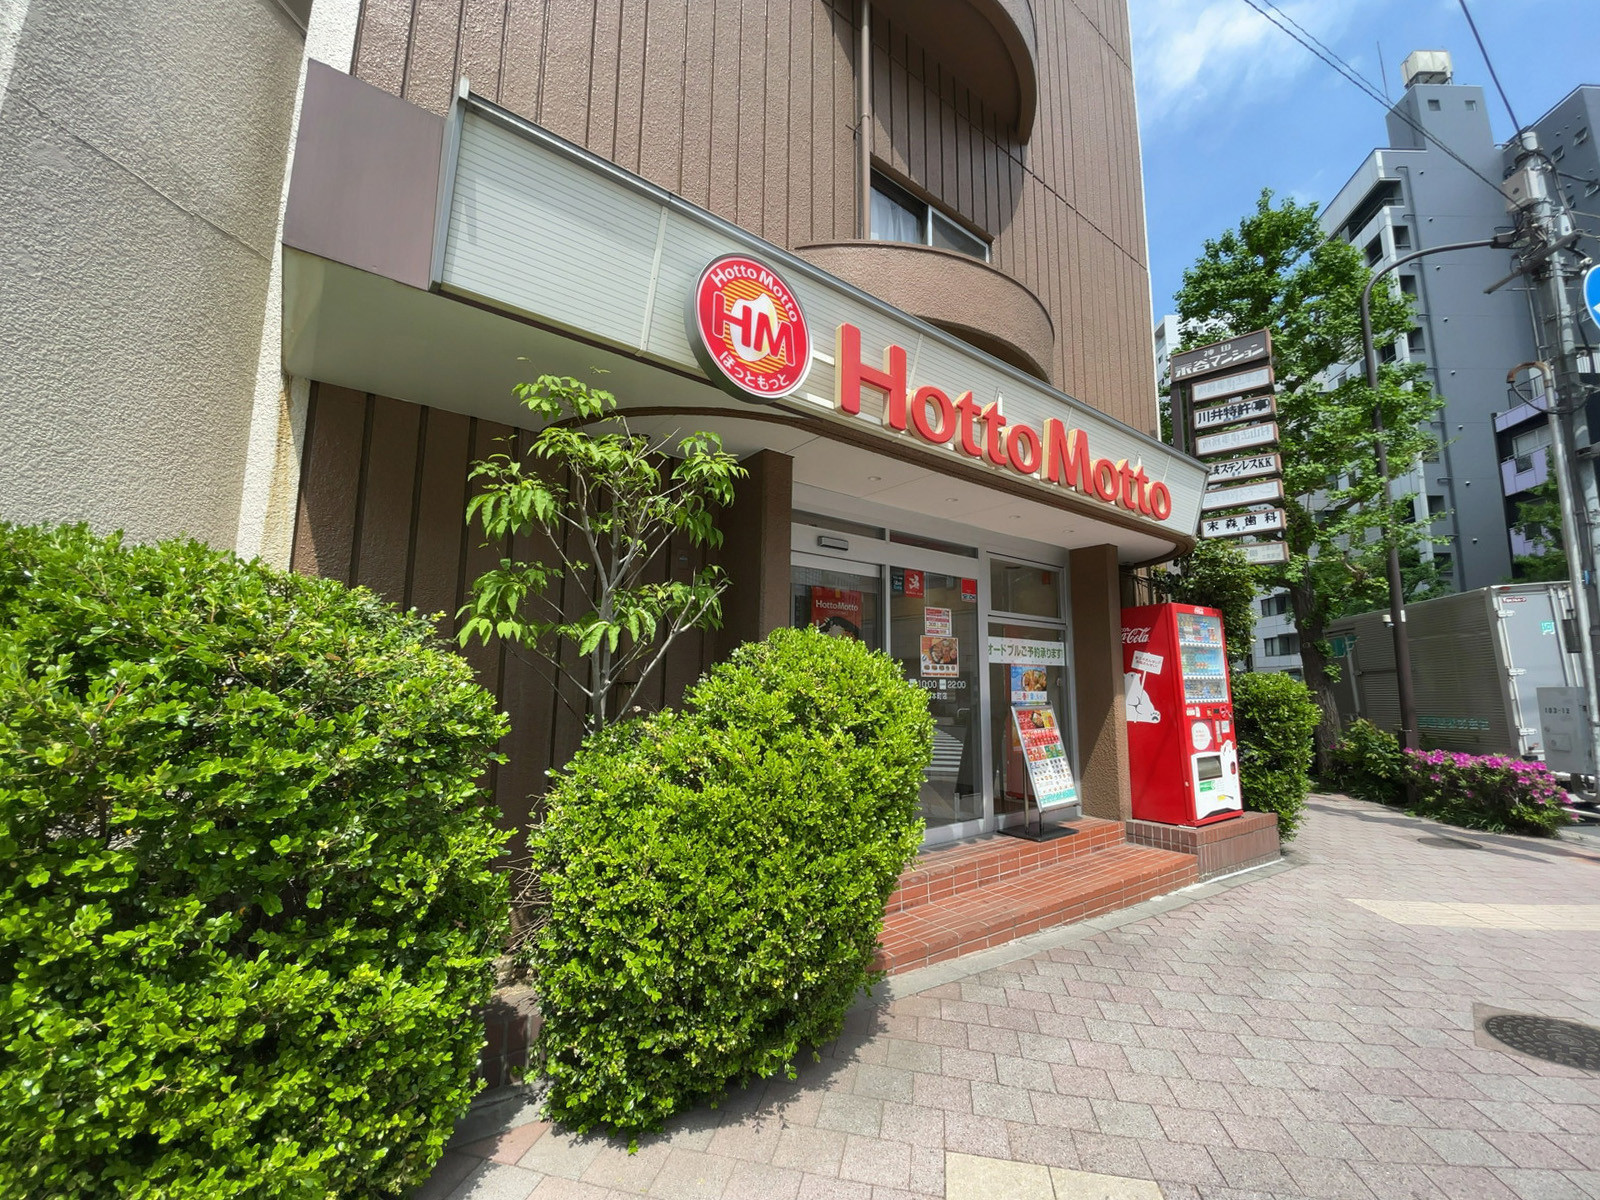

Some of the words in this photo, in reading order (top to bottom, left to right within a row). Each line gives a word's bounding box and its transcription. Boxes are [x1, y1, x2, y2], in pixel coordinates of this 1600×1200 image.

[710, 264, 757, 288] Hotto
[758, 270, 798, 323] Motto
[712, 291, 796, 367] HM
[719, 351, 790, 390] ほっともっと
